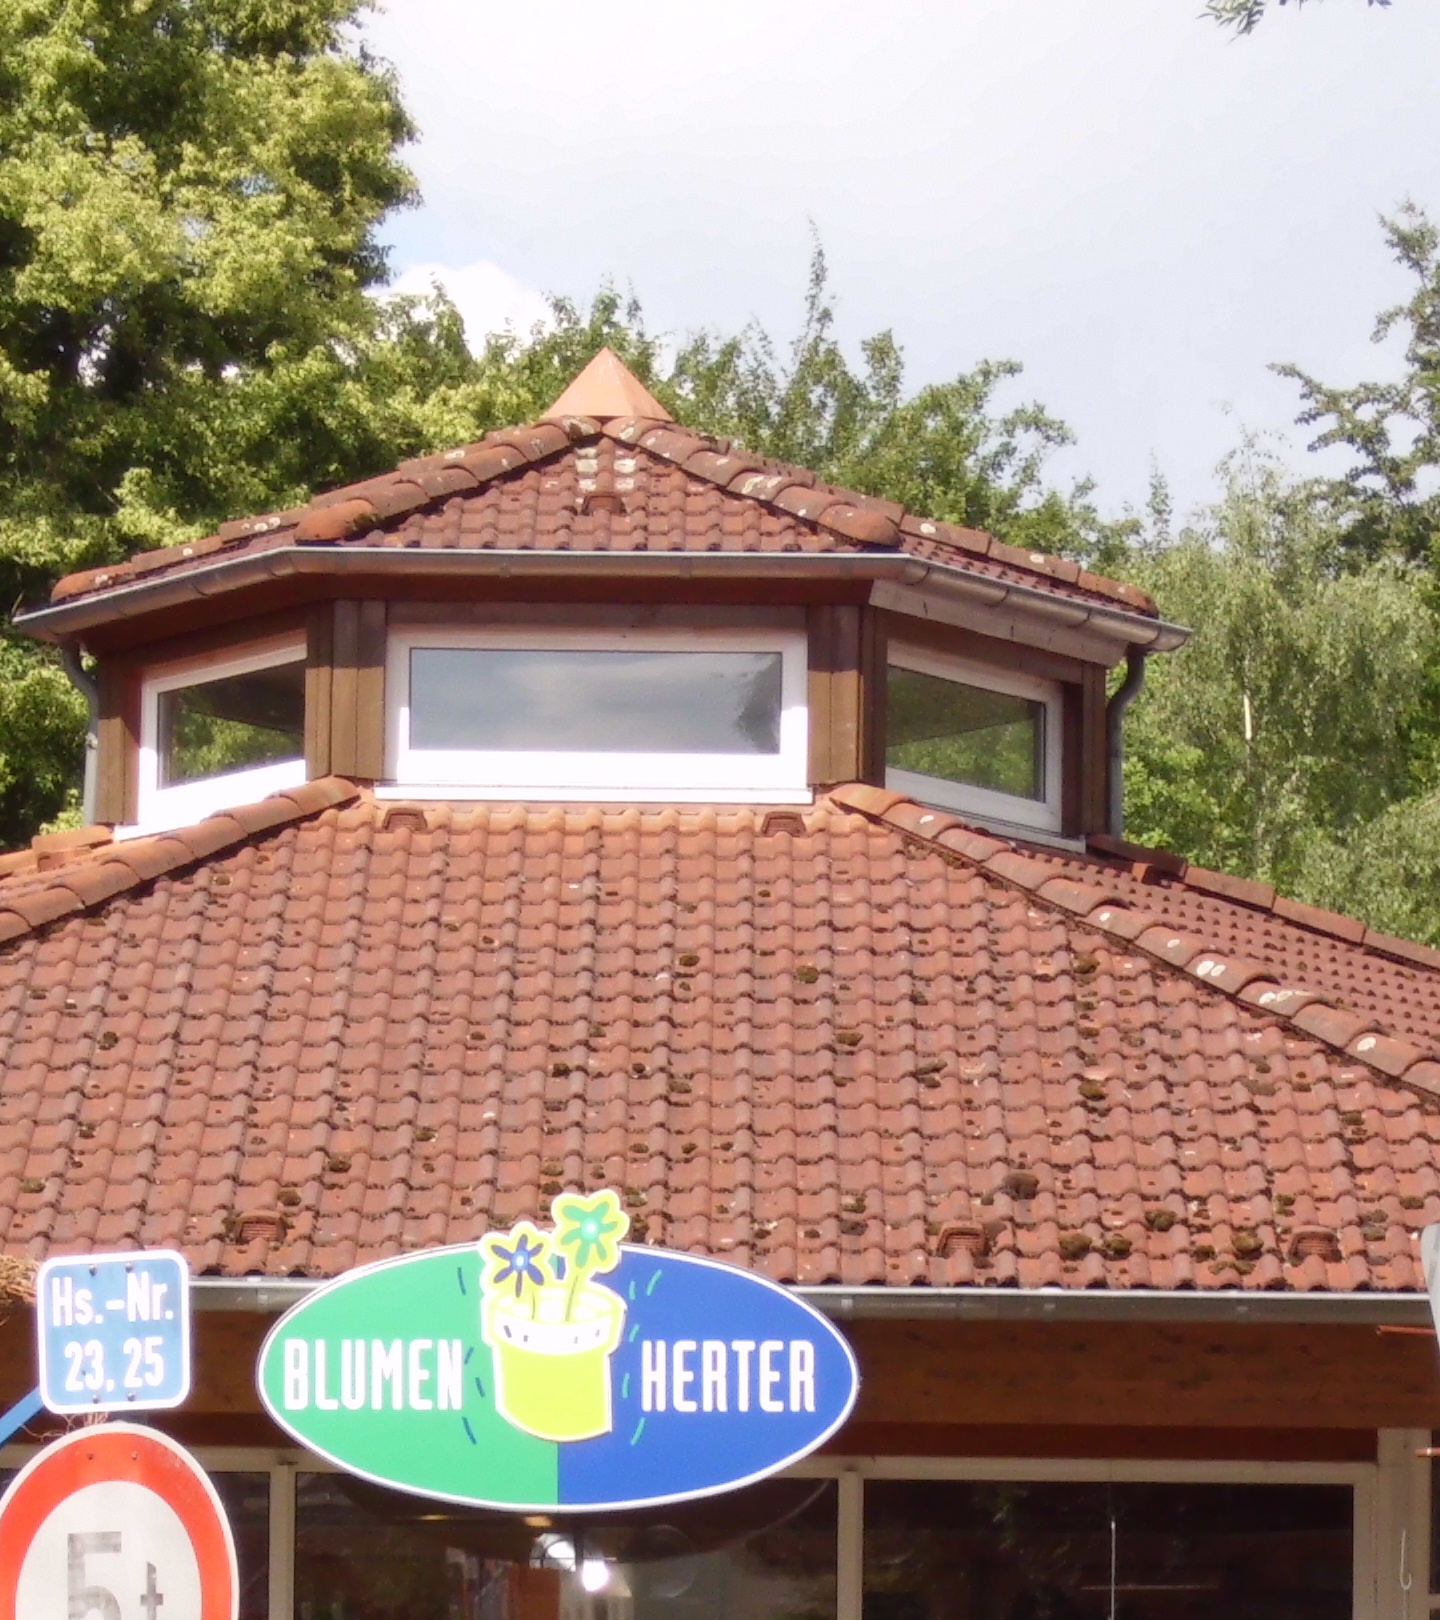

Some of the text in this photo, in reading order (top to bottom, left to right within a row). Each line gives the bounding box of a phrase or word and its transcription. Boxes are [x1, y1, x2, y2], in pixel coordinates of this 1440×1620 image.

[52, 1271, 174, 1326] Hs.-Nr.
[64, 1336, 164, 1392] 23, 25
[283, 1338, 816, 1413] BLUMEN HERTER
